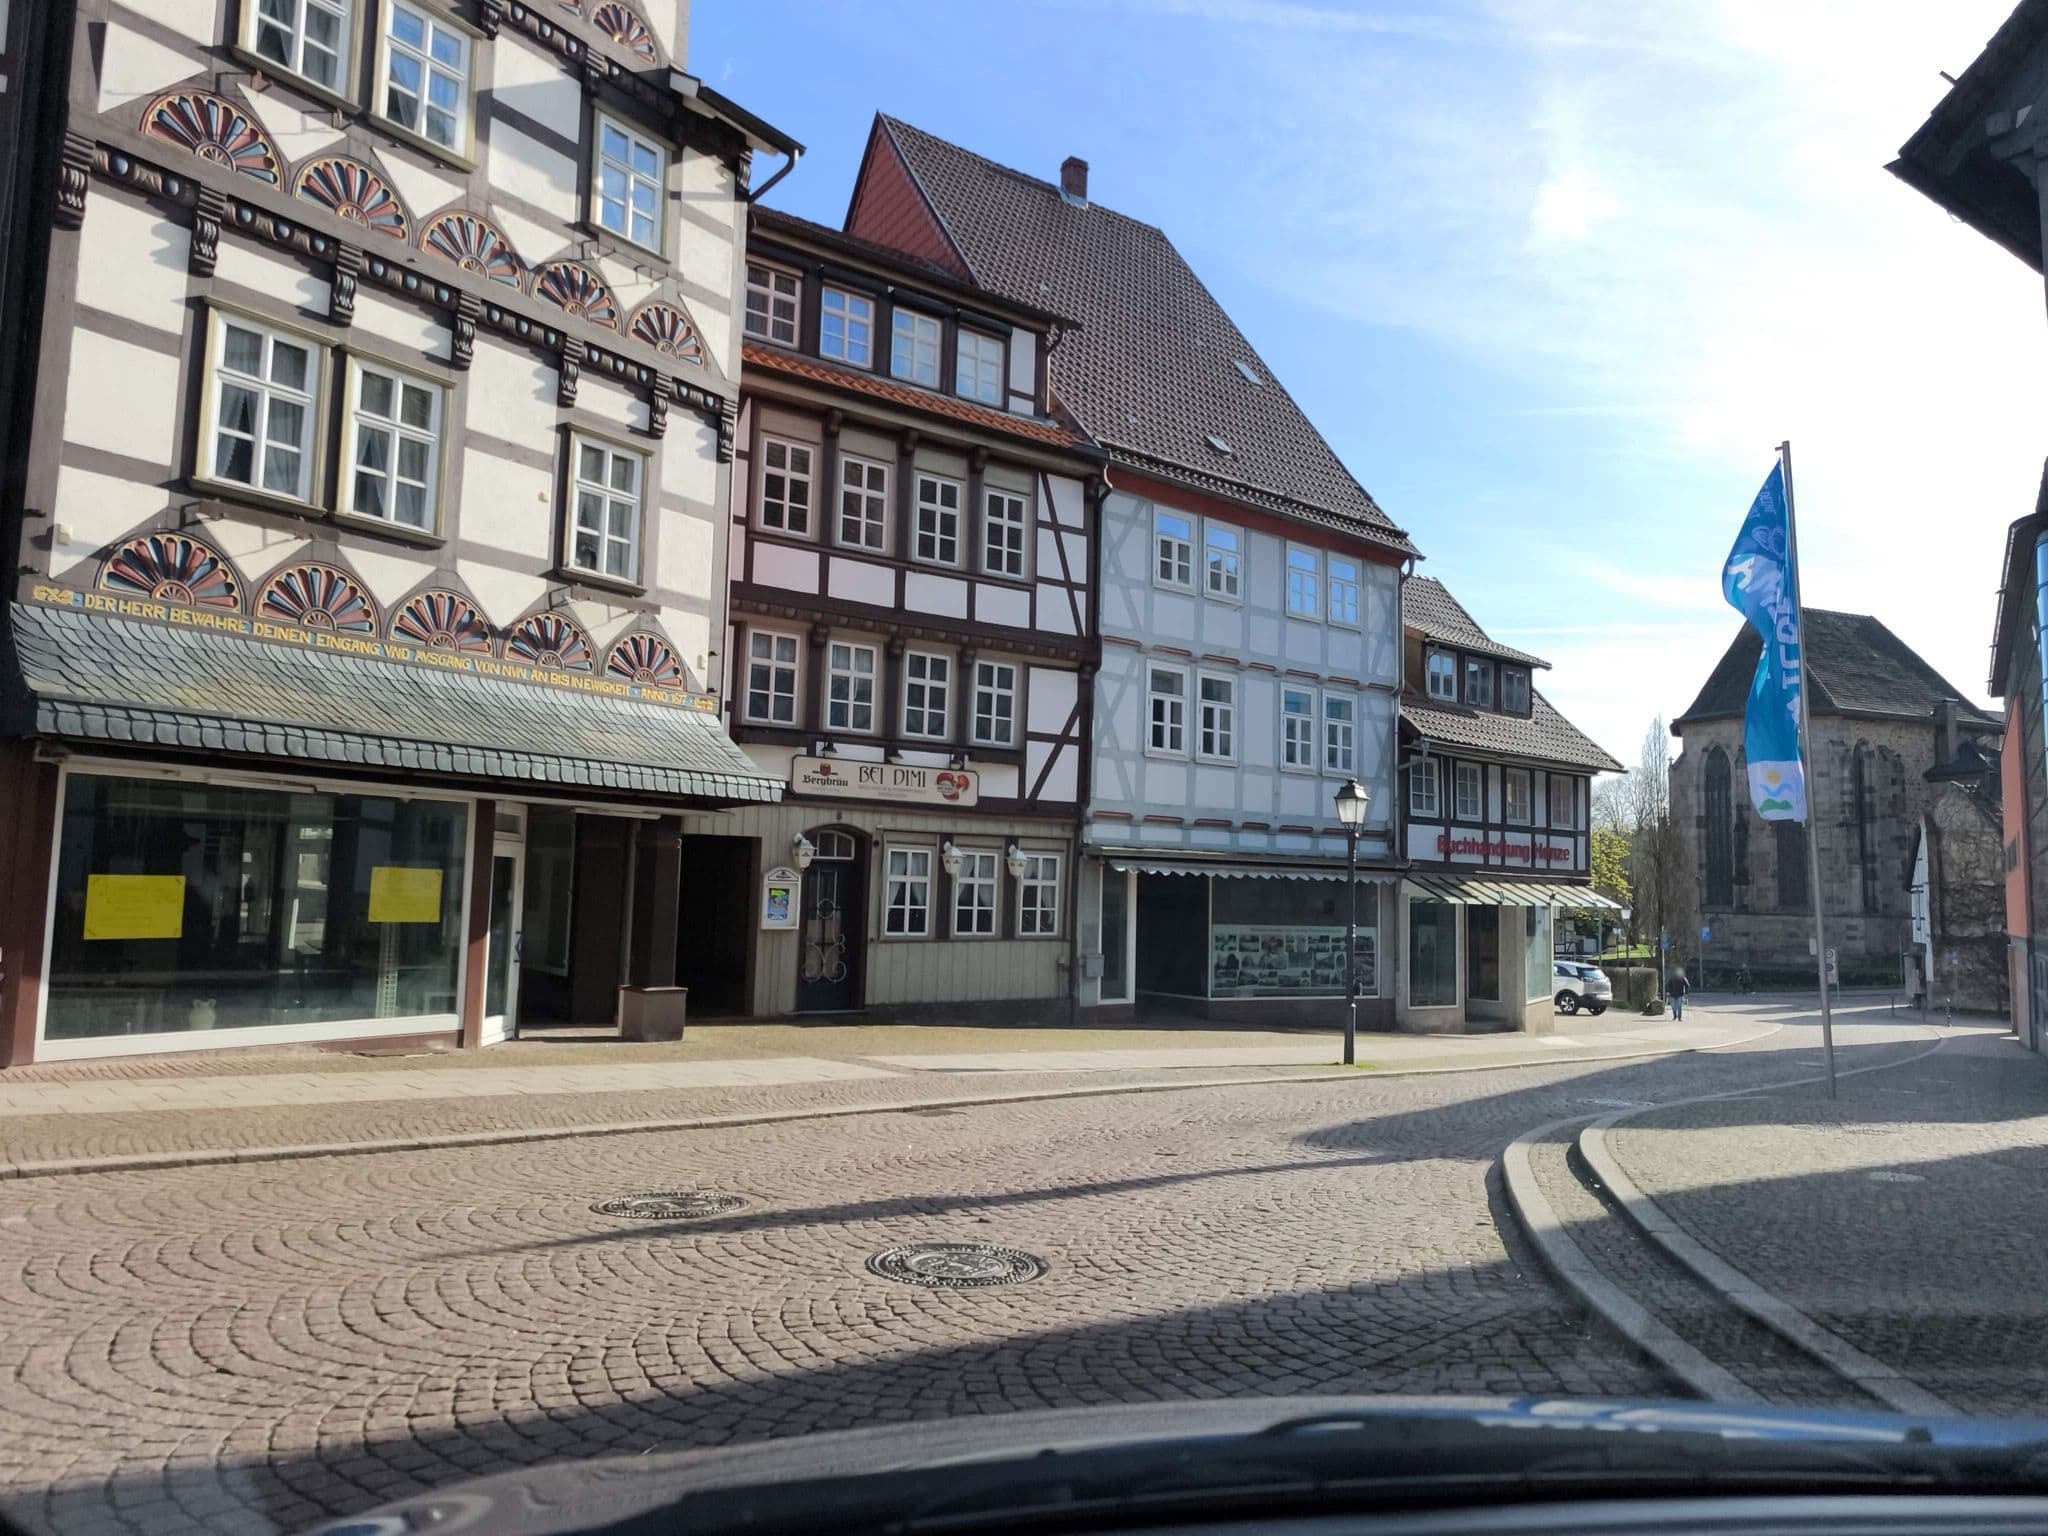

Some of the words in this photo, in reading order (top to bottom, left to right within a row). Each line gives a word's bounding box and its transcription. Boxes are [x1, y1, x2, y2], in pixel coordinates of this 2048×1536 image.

[84, 592, 118, 613] DER
[118, 601, 166, 620] HERR
[169, 607, 249, 633] BEWAHRE
[252, 621, 311, 643] DEINEN
[316, 633, 381, 656] EINGANG
[474, 659, 500, 675] VON
[640, 687, 668, 703] ANNO
[858, 765, 884, 785] BEI
[893, 768, 927, 788] DIMI
[1437, 834, 1530, 863] Buchhandlung
